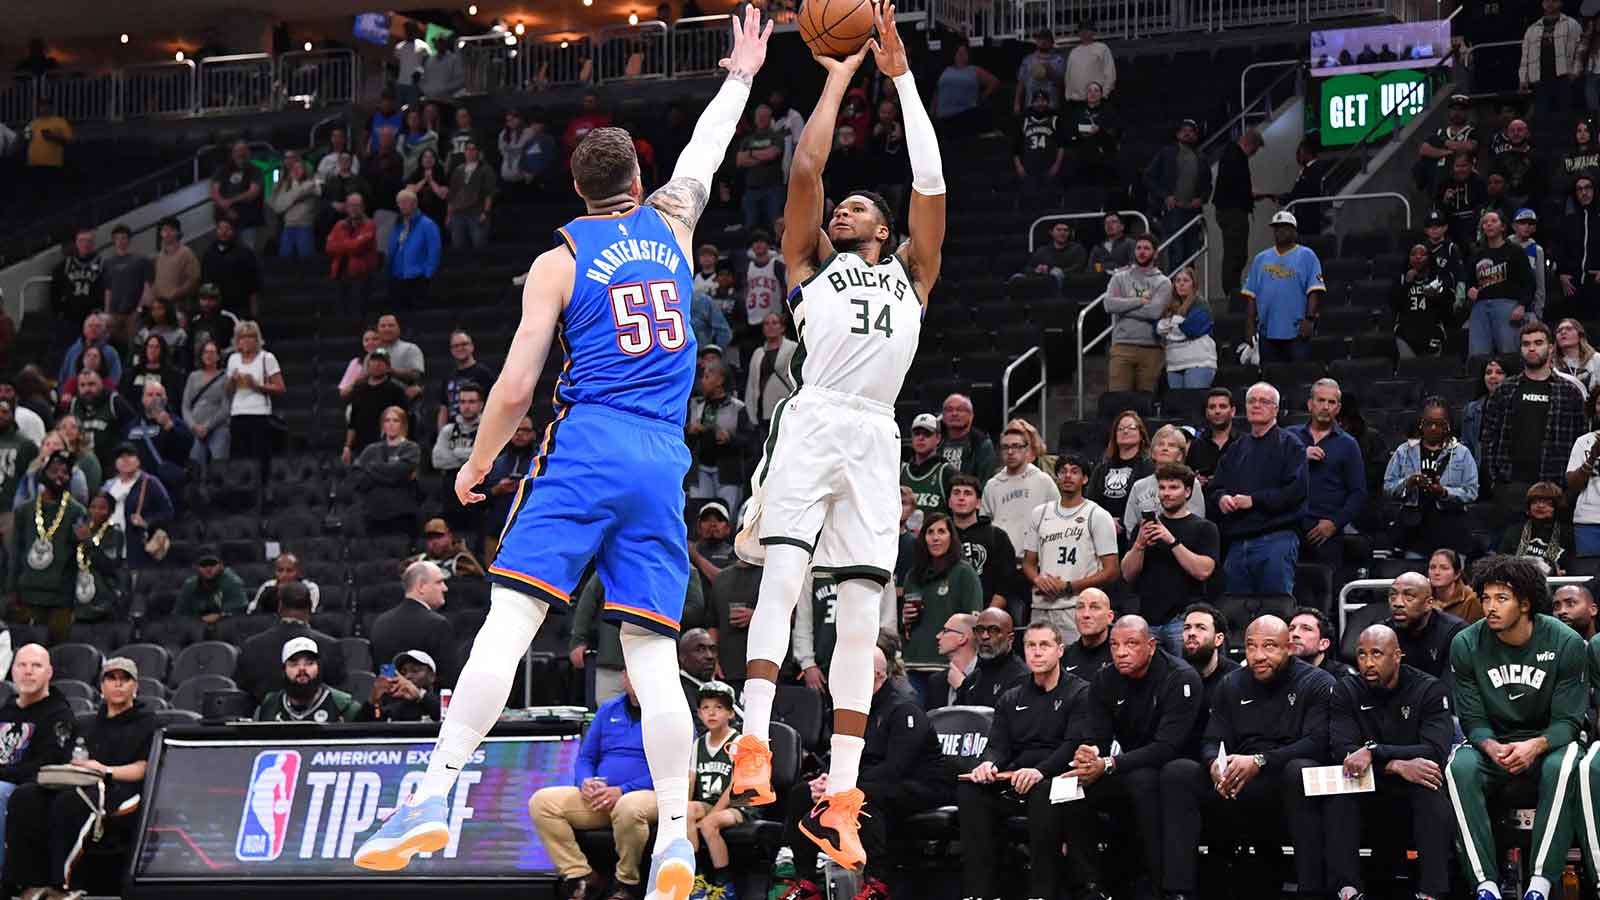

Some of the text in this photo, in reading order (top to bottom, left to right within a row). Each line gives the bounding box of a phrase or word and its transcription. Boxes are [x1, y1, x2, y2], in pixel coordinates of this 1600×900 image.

[1329, 81, 1424, 128] GET UP!!
[1030, 136, 1046, 149] 34
[585, 239, 680, 285] HARTENSTEIN
[827, 267, 907, 301] BUCKS
[1410, 297, 1426, 310] 34
[608, 280, 687, 356] 55
[850, 298, 893, 338] 34
[1522, 393, 1549, 402] NIKE
[1064, 527, 1083, 541] City
[1057, 546, 1077, 565] 34
[824, 600, 836, 623] 3
[1487, 664, 1546, 690] BUCKS
[312, 750, 485, 765] AMERICAN EXSS
[937, 733, 988, 758] THE Ap
[299, 771, 482, 858] TIP-F
